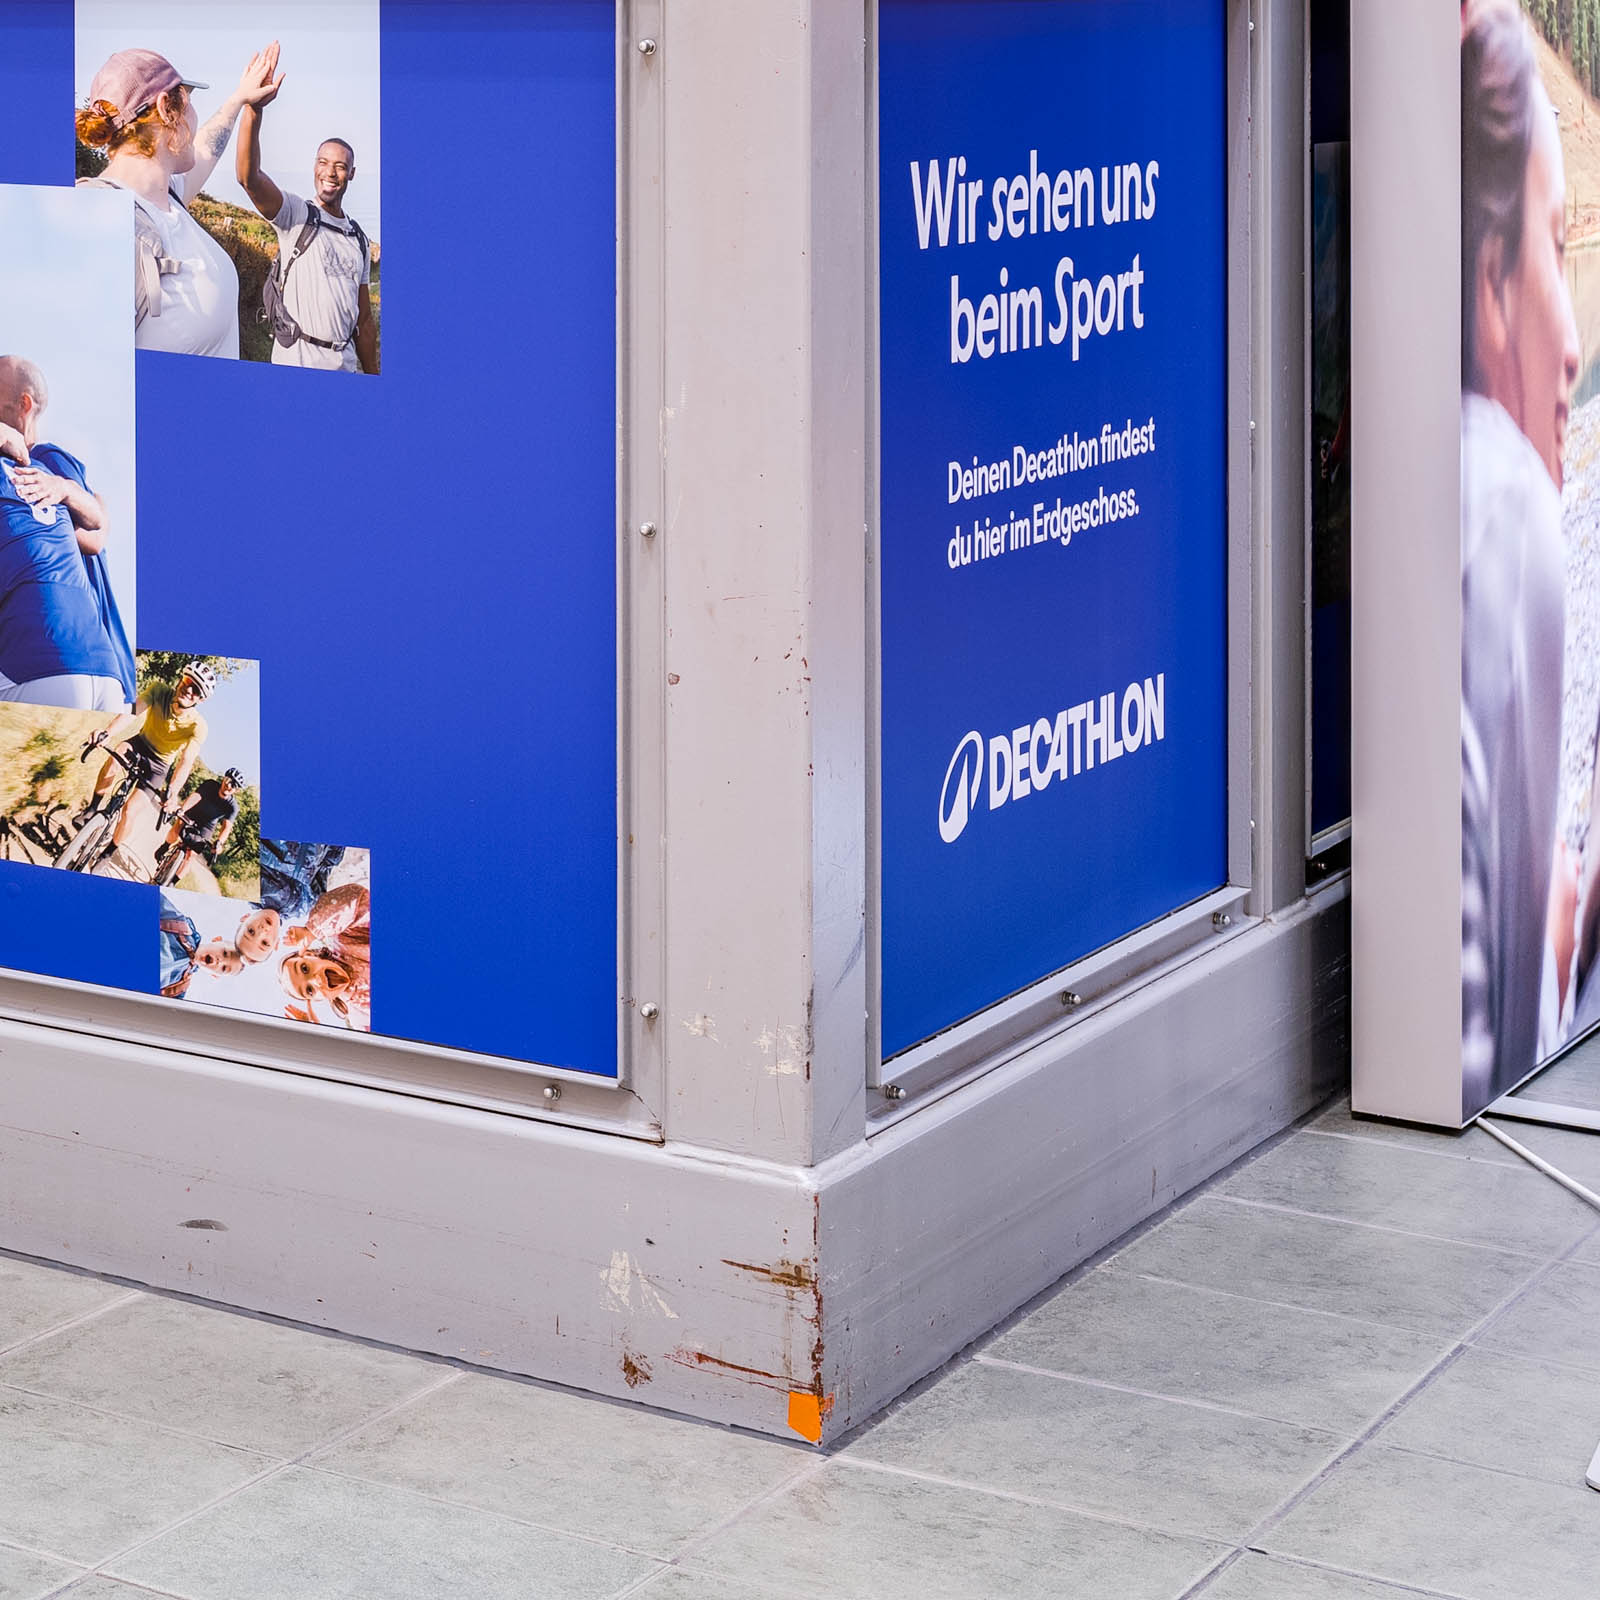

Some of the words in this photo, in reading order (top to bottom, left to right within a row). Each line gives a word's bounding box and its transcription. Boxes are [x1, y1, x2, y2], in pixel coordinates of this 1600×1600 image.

[910, 156, 983, 249] Wir
[988, 149, 1094, 241] sehen
[1102, 160, 1159, 225] uns
[951, 267, 1043, 364] beim
[1049, 253, 1144, 362] Sport
[948, 456, 1011, 504] Deinen
[1013, 432, 1099, 487] Decathlon
[1100, 416, 1155, 464] findest
[948, 525, 972, 569] du
[974, 517, 1008, 561] hier
[1009, 510, 1031, 551] im
[1032, 486, 1140, 546] Erdgeschoss.
[990, 672, 1165, 811] DECATHLON
